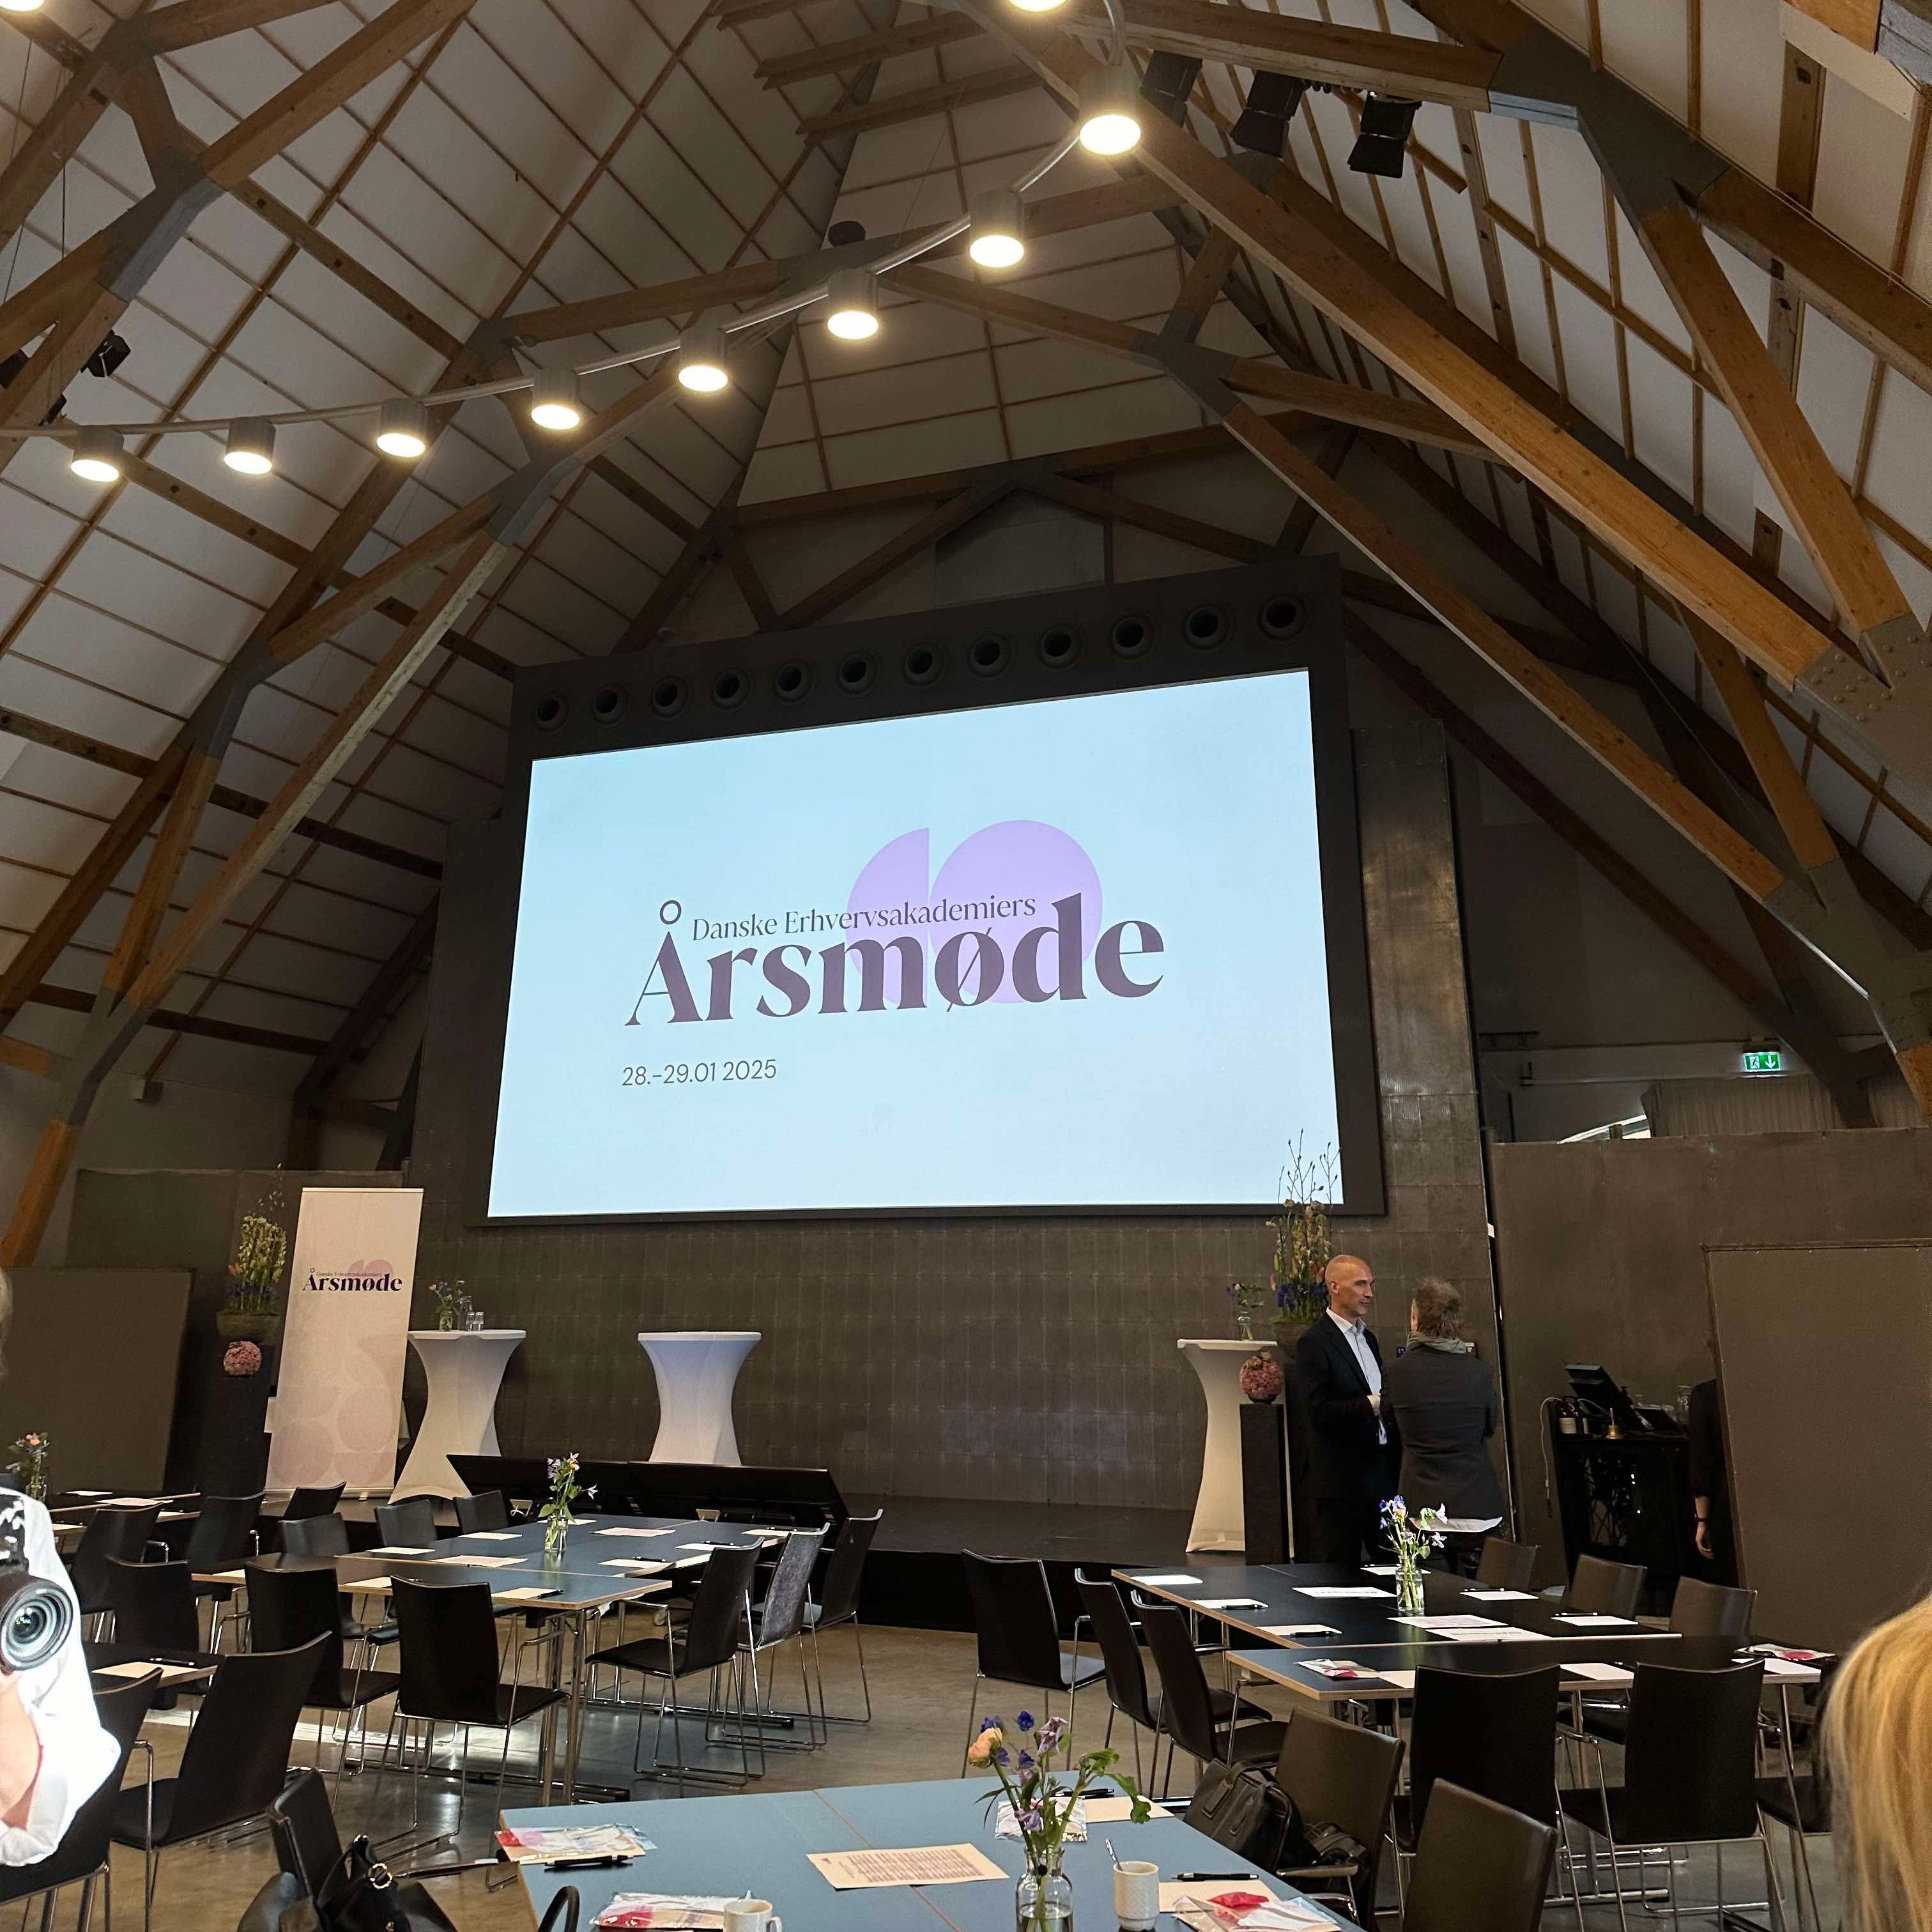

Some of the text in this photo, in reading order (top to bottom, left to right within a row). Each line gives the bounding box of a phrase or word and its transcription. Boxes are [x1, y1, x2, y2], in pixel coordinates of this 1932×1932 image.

[692, 894, 1036, 940] Danske Erhvervsakademiers
[624, 892, 1164, 1026] Årsmøde
[723, 1059, 776, 1081] 2025
[302, 1268, 403, 1292] Årsmøde
